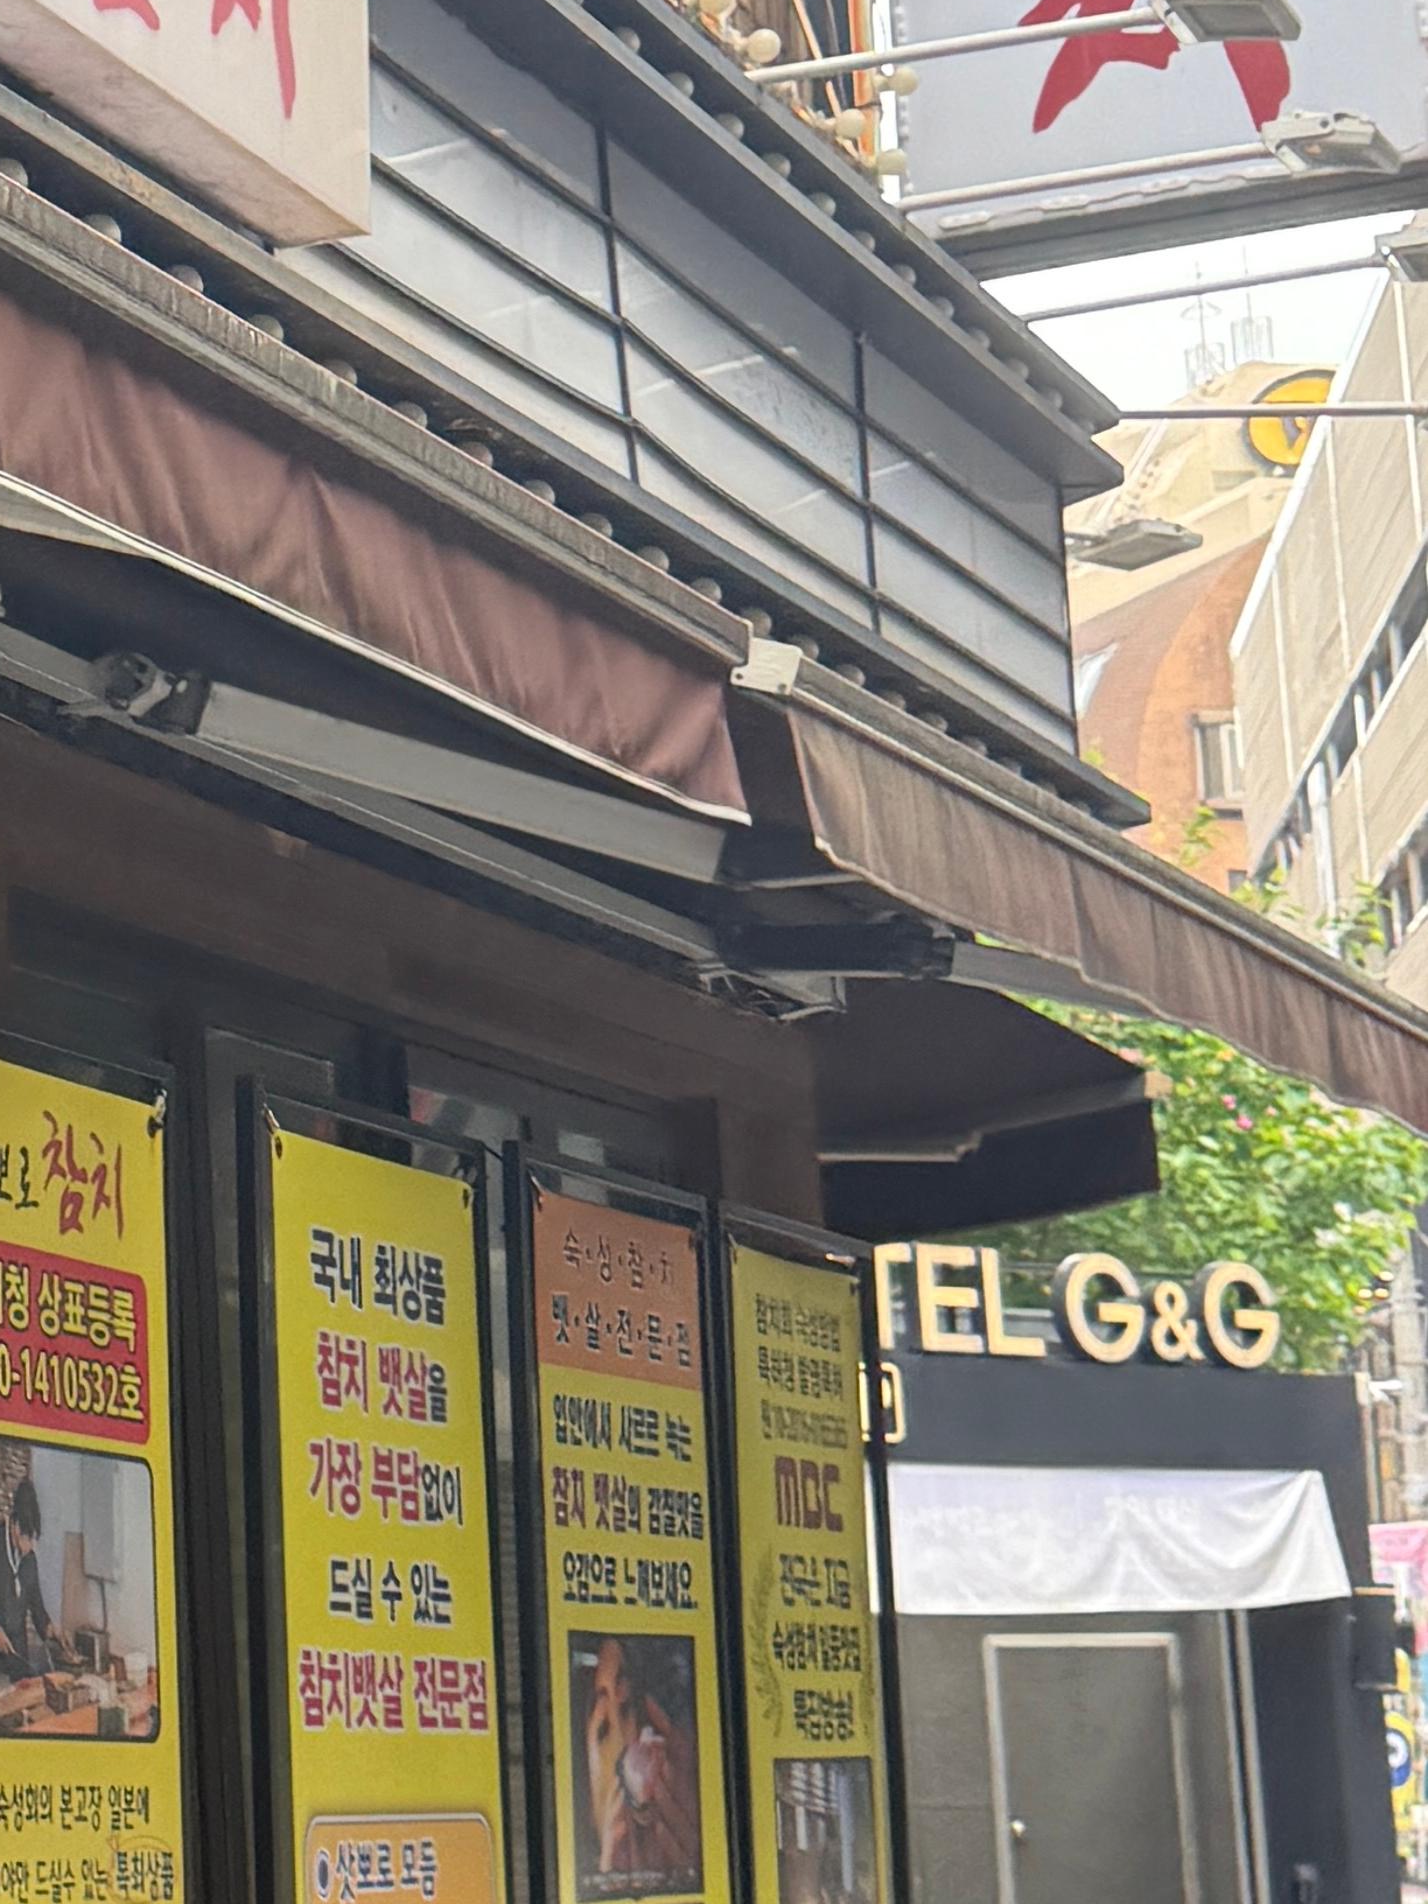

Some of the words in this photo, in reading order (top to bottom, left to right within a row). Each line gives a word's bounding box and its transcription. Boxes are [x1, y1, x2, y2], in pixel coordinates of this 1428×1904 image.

[41, 1109, 125, 1240] 참치
[35, 1270, 139, 1354] 상표등록
[310, 1228, 364, 1310] 국내
[373, 1244, 447, 1326] 최상품
[1056, 1251, 1280, 1369] G&G
[317, 1331, 369, 1414] 참치
[378, 1347, 448, 1424] 뱃살을
[309, 1440, 363, 1516] 가장
[371, 1446, 464, 1526] 부담없이
[774, 1455, 844, 1533] MBC
[329, 1559, 374, 1619] 드실
[381, 1564, 403, 1622] 수
[410, 1563, 452, 1624] 있는
[299, 1649, 405, 1729] 참치뱃살
[413, 1658, 489, 1730] 전문점
[59, 1785, 103, 1833] 본고장
[34, 1860, 77, 1904] 드실수
[400, 1841, 438, 1897] 모듬
